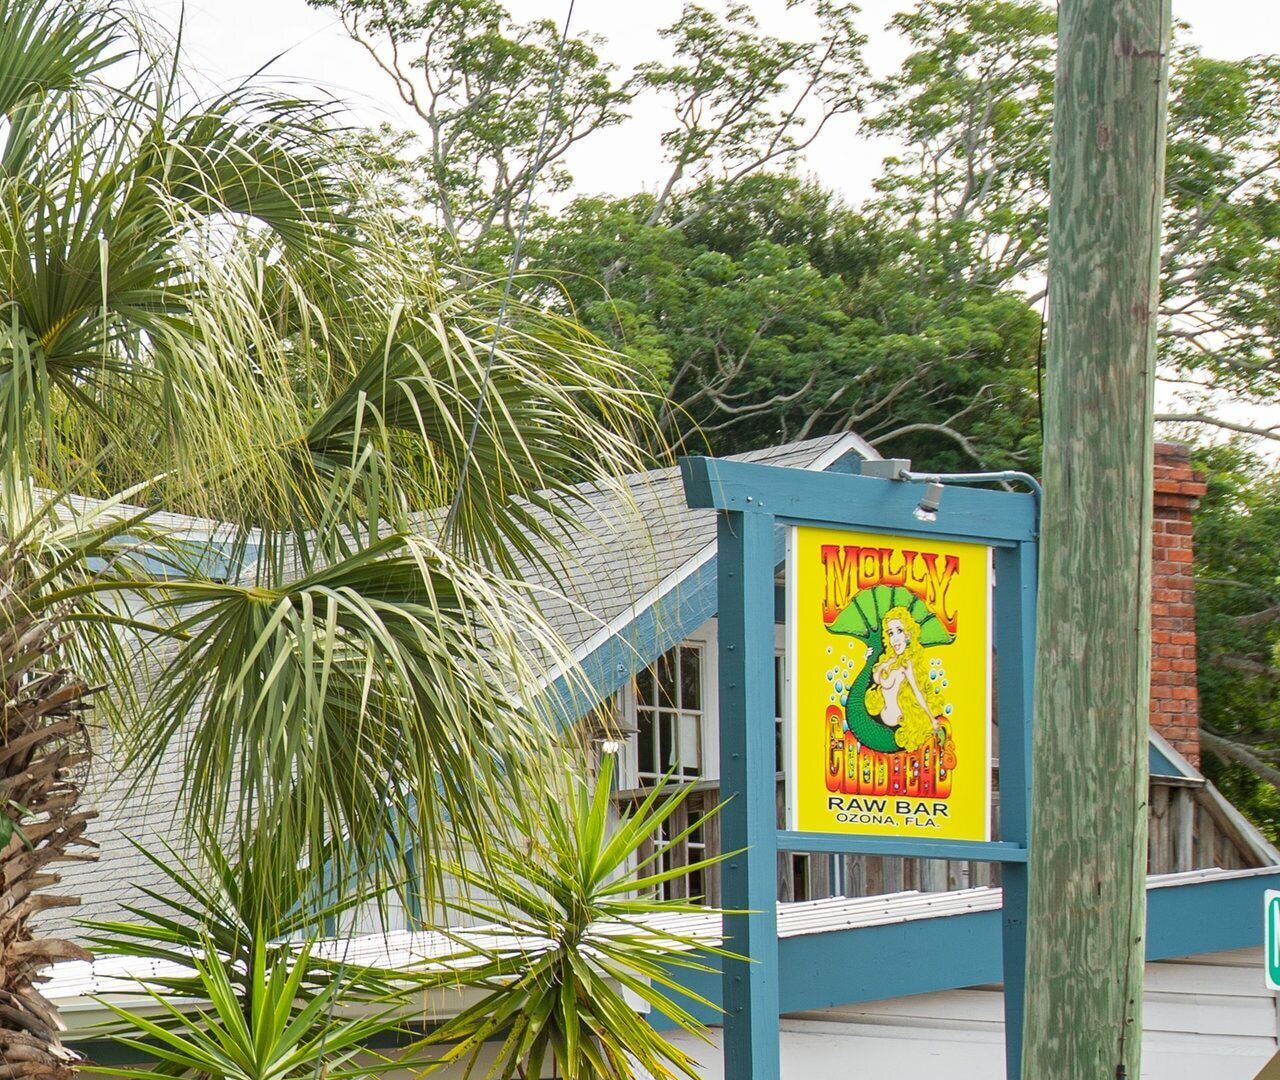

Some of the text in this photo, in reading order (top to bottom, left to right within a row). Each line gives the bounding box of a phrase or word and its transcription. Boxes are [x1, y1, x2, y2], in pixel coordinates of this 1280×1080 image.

[821, 544, 960, 634] MOLLY
[828, 797, 949, 816] RAW BAR
[836, 813, 940, 828] OZONA, FLA.
